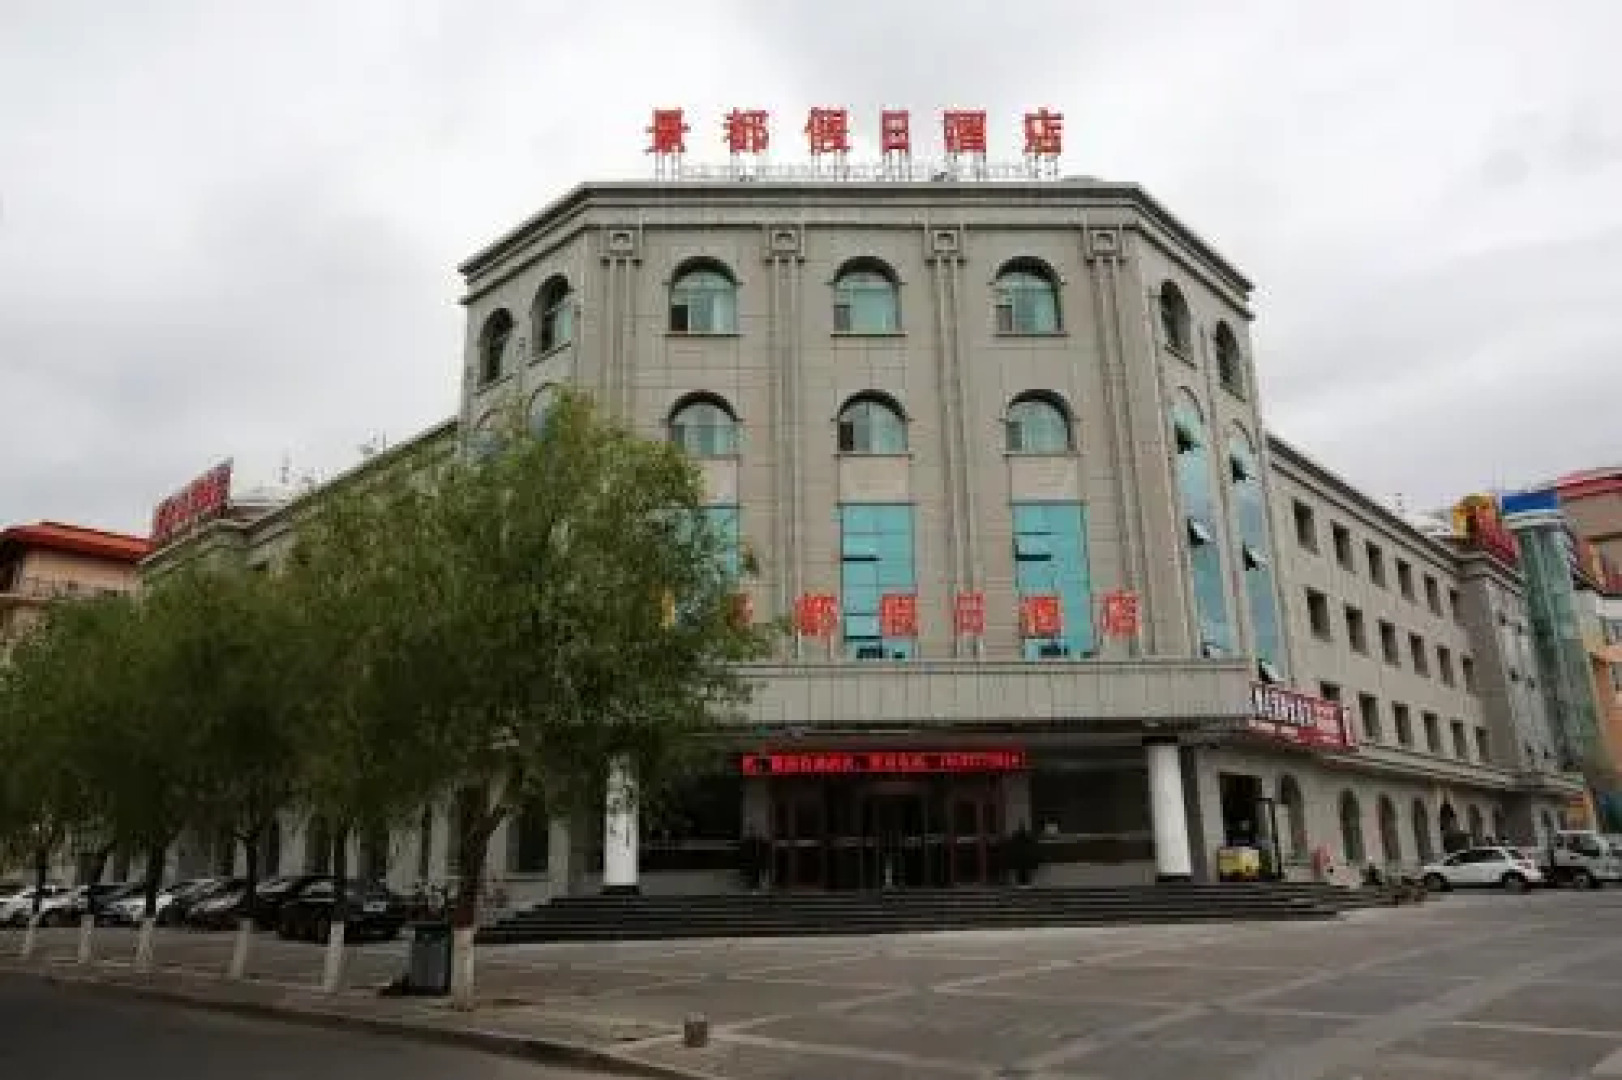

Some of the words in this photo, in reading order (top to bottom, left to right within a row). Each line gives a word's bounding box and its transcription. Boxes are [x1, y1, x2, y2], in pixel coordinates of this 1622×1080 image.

[645, 107, 1064, 154] 景都假日酒店
